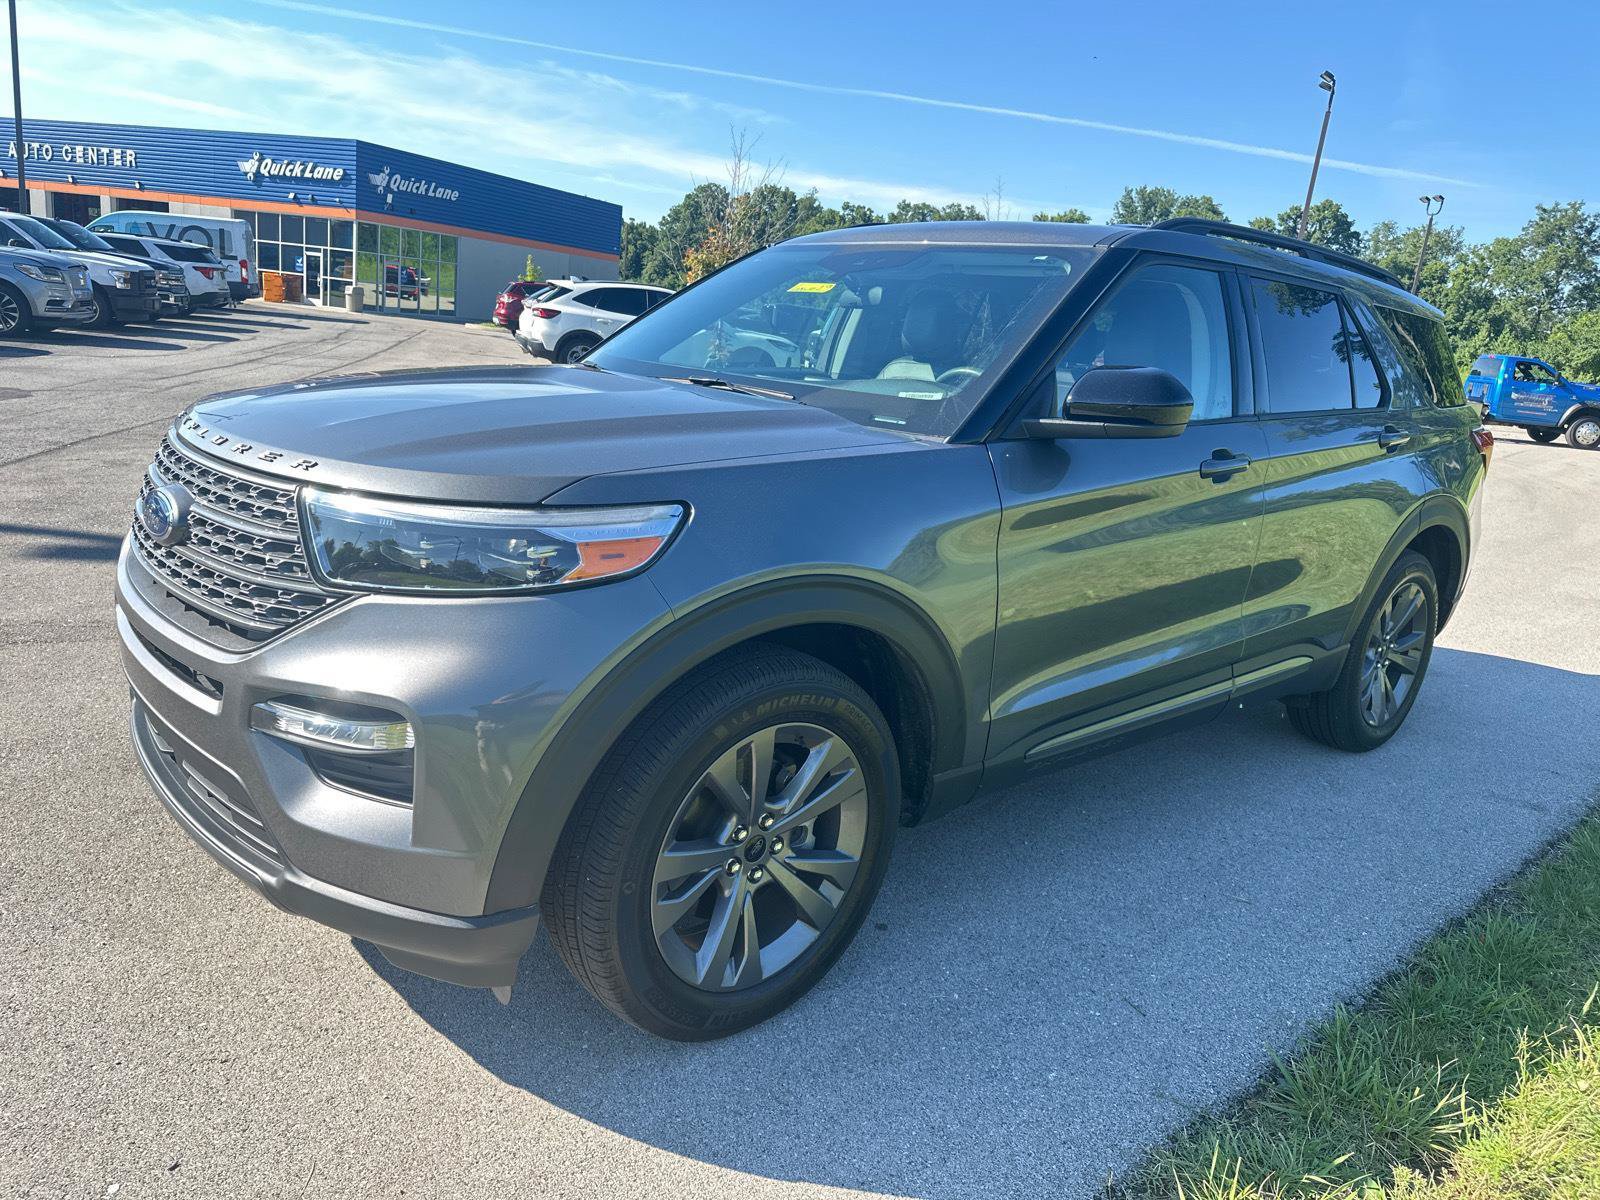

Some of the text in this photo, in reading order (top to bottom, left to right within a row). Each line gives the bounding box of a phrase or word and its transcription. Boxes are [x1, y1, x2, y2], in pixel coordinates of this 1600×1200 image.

[8, 141, 137, 167] AUTO CENTER
[260, 158, 344, 180] Quick Lane
[390, 174, 459, 201] Quick Lane
[756, 694, 836, 716] MICHELIN
